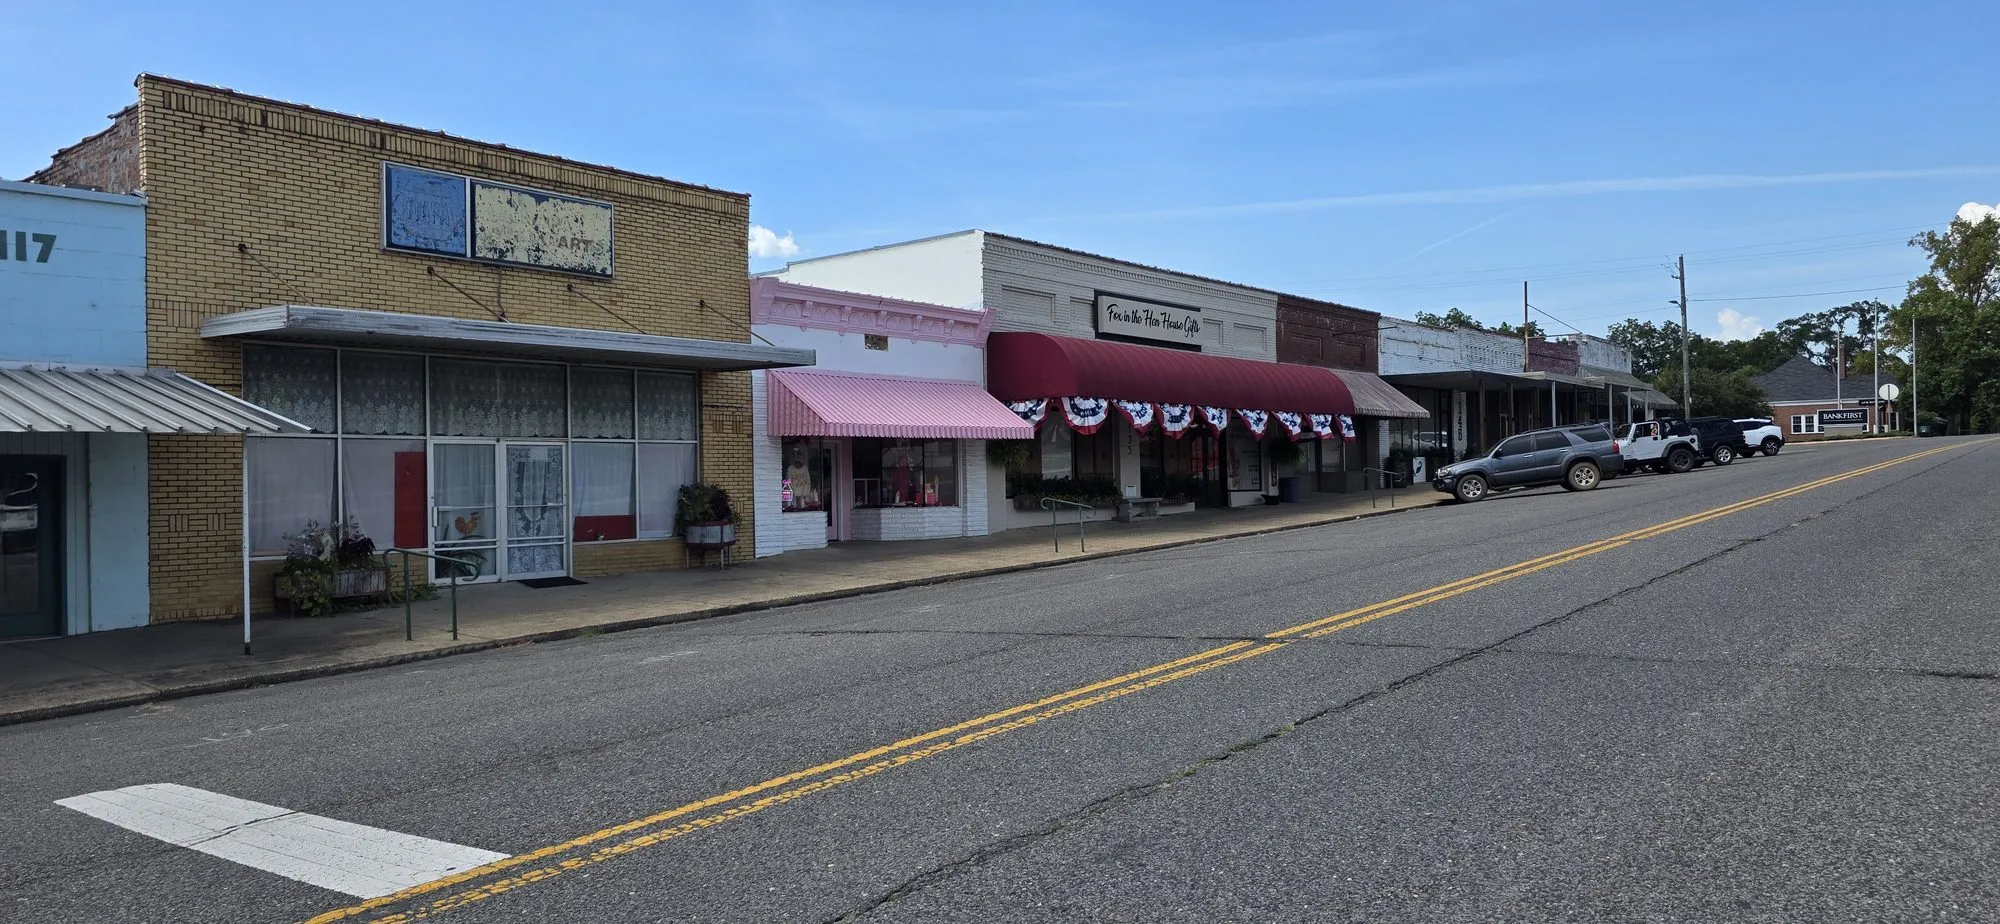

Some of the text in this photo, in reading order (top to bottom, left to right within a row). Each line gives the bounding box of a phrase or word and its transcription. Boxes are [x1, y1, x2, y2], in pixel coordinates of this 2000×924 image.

[0, 229, 57, 263] 117
[1107, 304, 1200, 338] Fox in the Hen House Gifts
[1823, 412, 1863, 420] BANKFIRST
